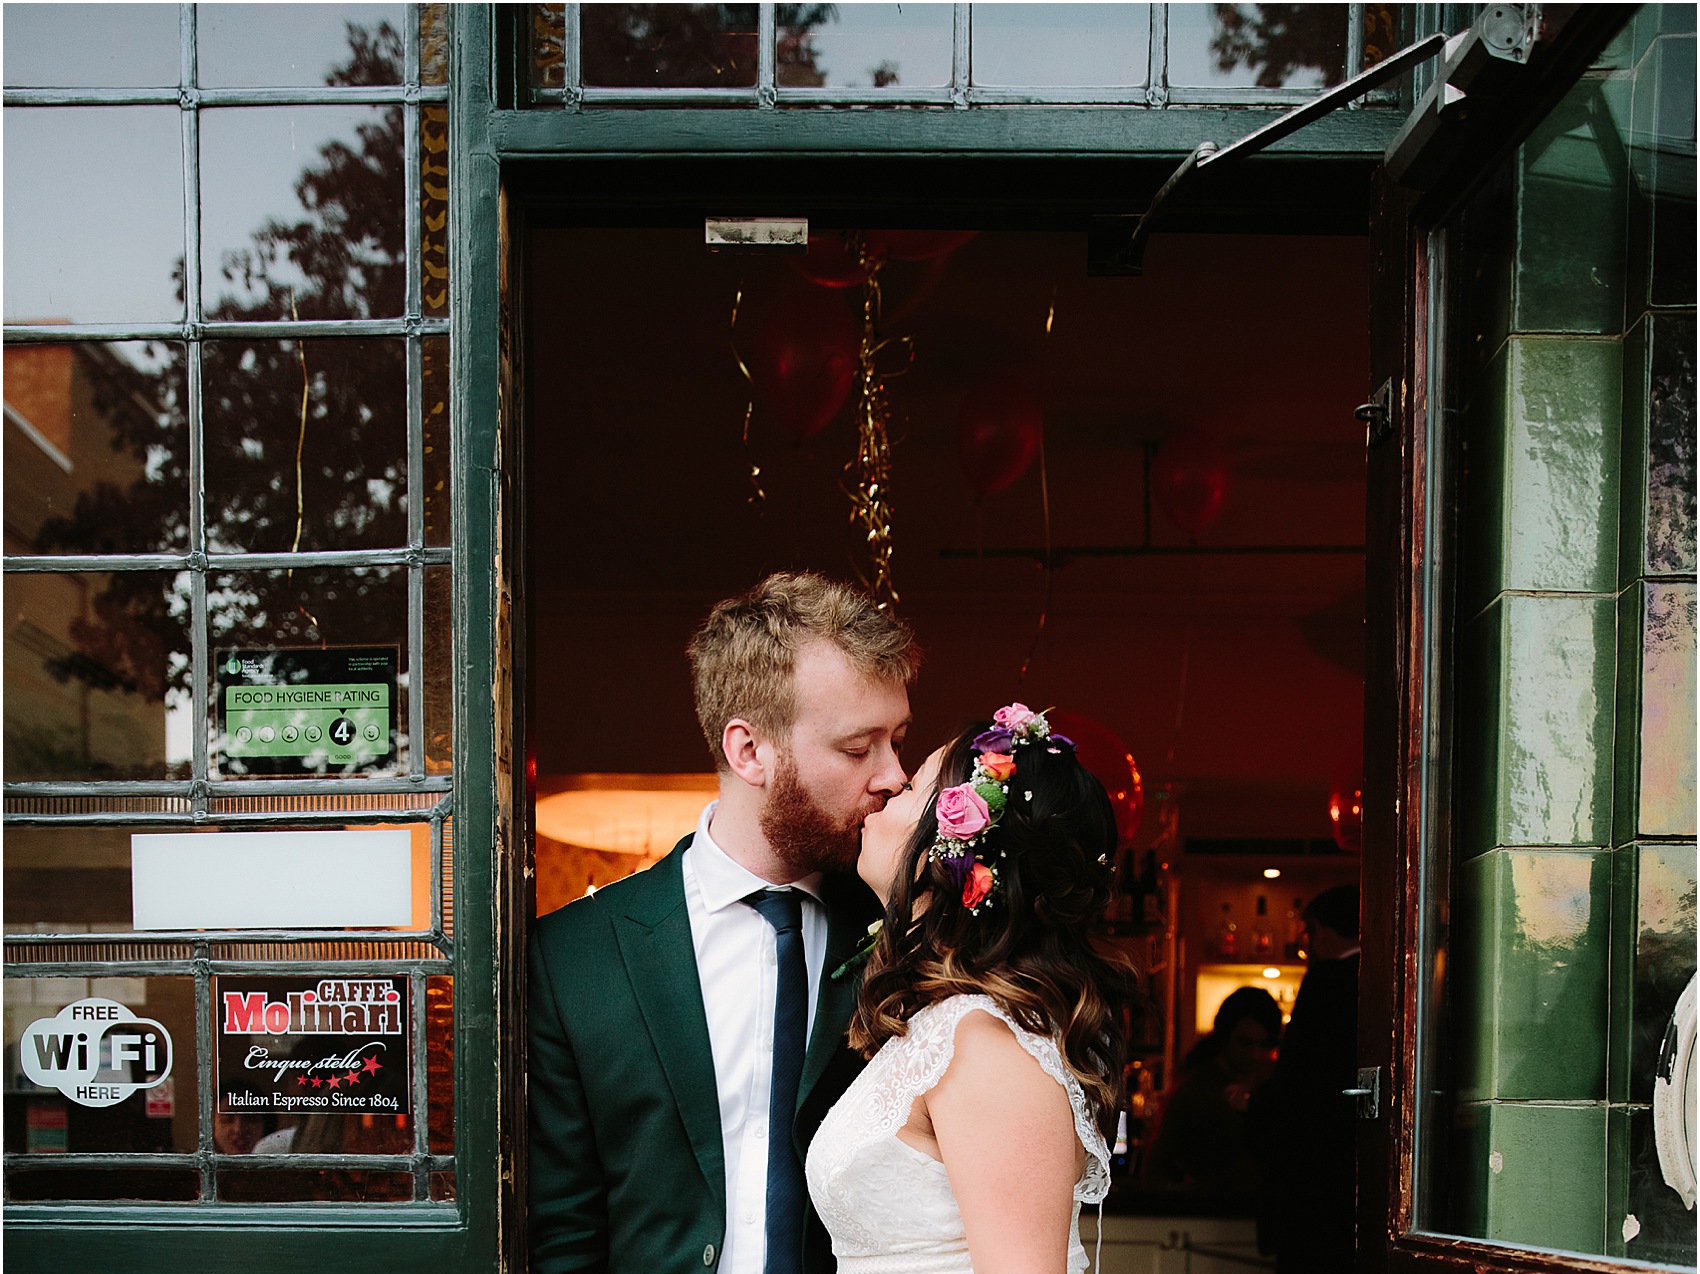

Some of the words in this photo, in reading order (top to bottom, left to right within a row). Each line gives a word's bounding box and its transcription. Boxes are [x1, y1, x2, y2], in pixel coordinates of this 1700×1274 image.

[234, 692, 273, 703] FOOD
[276, 691, 332, 703] HYGIENE
[334, 690, 380, 702] RATING
[334, 721, 350, 742] 4
[72, 1006, 119, 1020] FREE
[224, 990, 402, 1035] Molinari
[33, 1032, 88, 1071] Wi
[111, 1032, 157, 1071] Fi
[243, 1045, 311, 1083] Cinque
[307, 1041, 387, 1076] stelle
[76, 1086, 120, 1100] HERE
[227, 1090, 269, 1107] Italian
[273, 1092, 329, 1110] Espresso
[332, 1092, 366, 1107] Since
[369, 1093, 399, 1110] 1804
